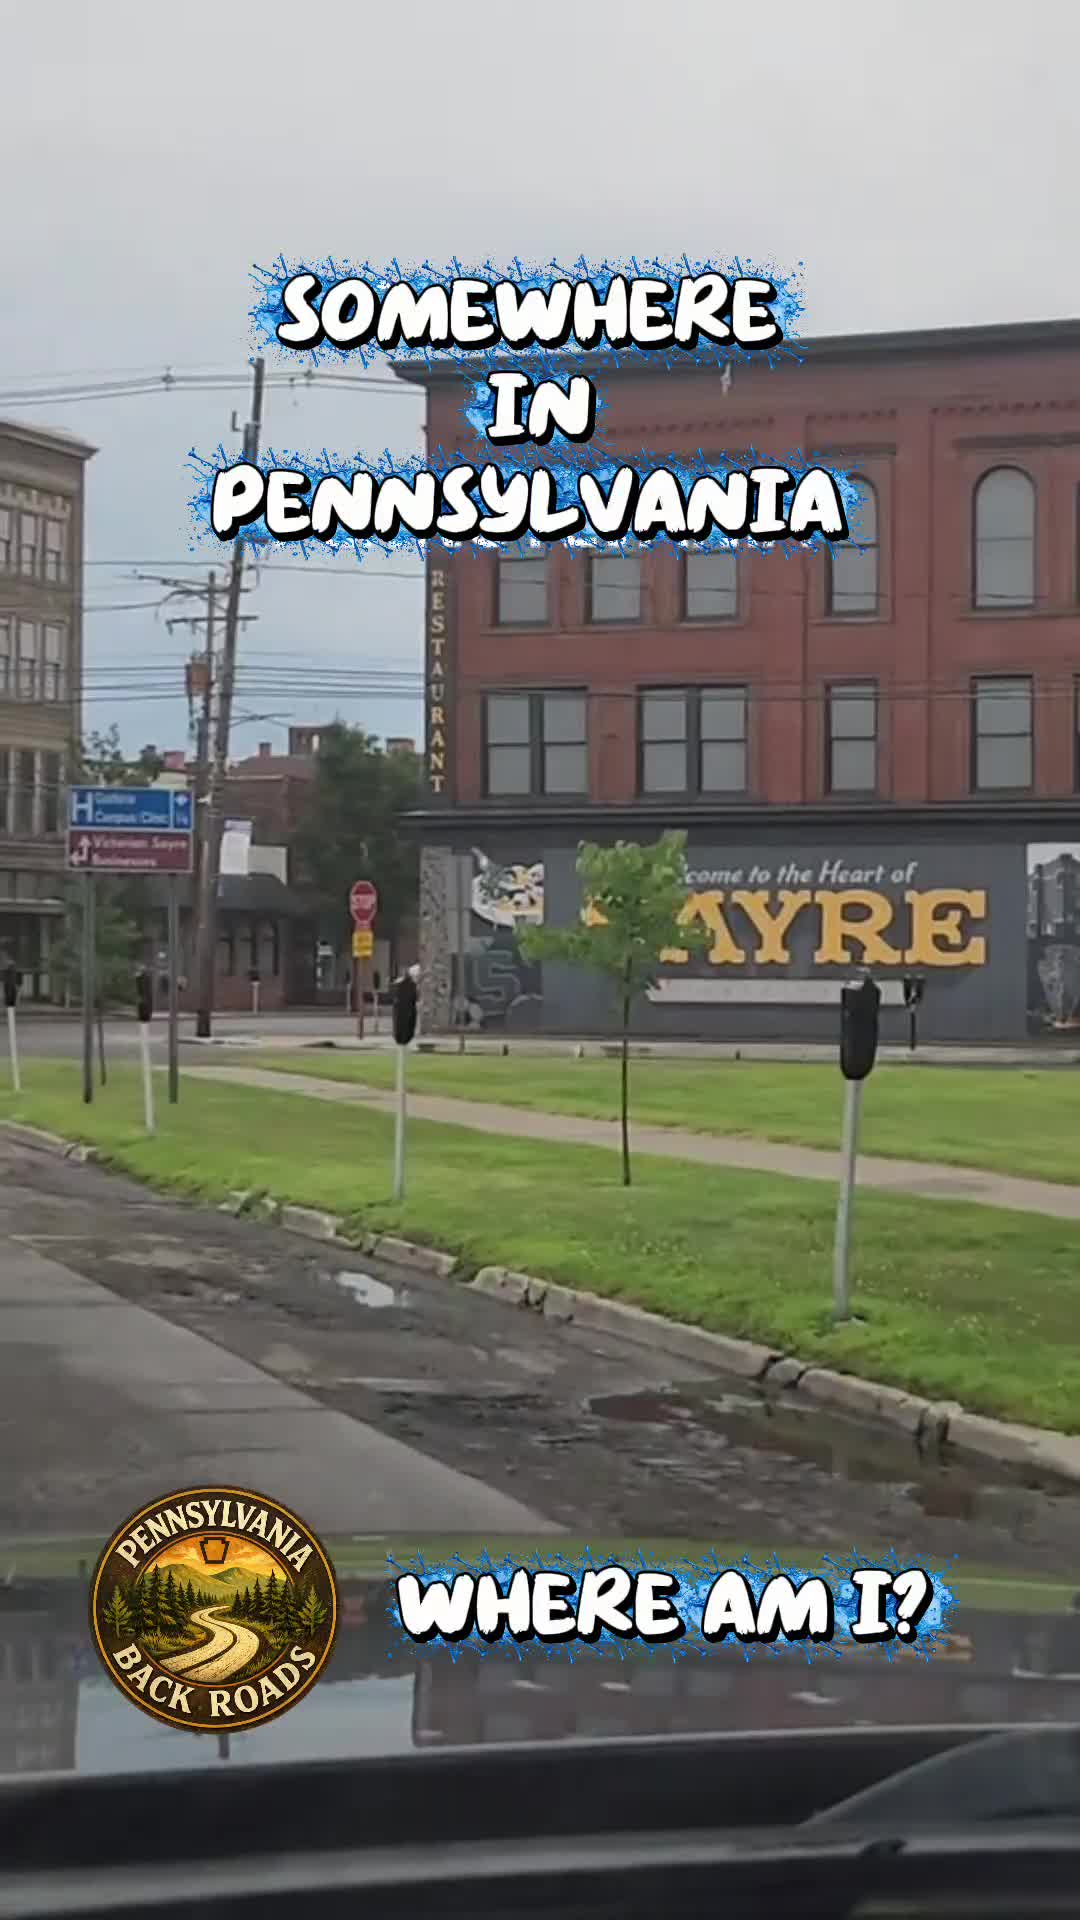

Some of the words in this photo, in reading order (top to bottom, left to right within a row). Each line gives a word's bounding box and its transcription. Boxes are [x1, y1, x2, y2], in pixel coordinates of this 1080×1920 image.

[430, 569, 446, 793] RESTAURANT
[749, 865, 771, 884] to
[776, 863, 813, 884] the
[818, 859, 885, 884] Heart
[890, 861, 919, 884] of
[580, 887, 988, 966] AYRE
